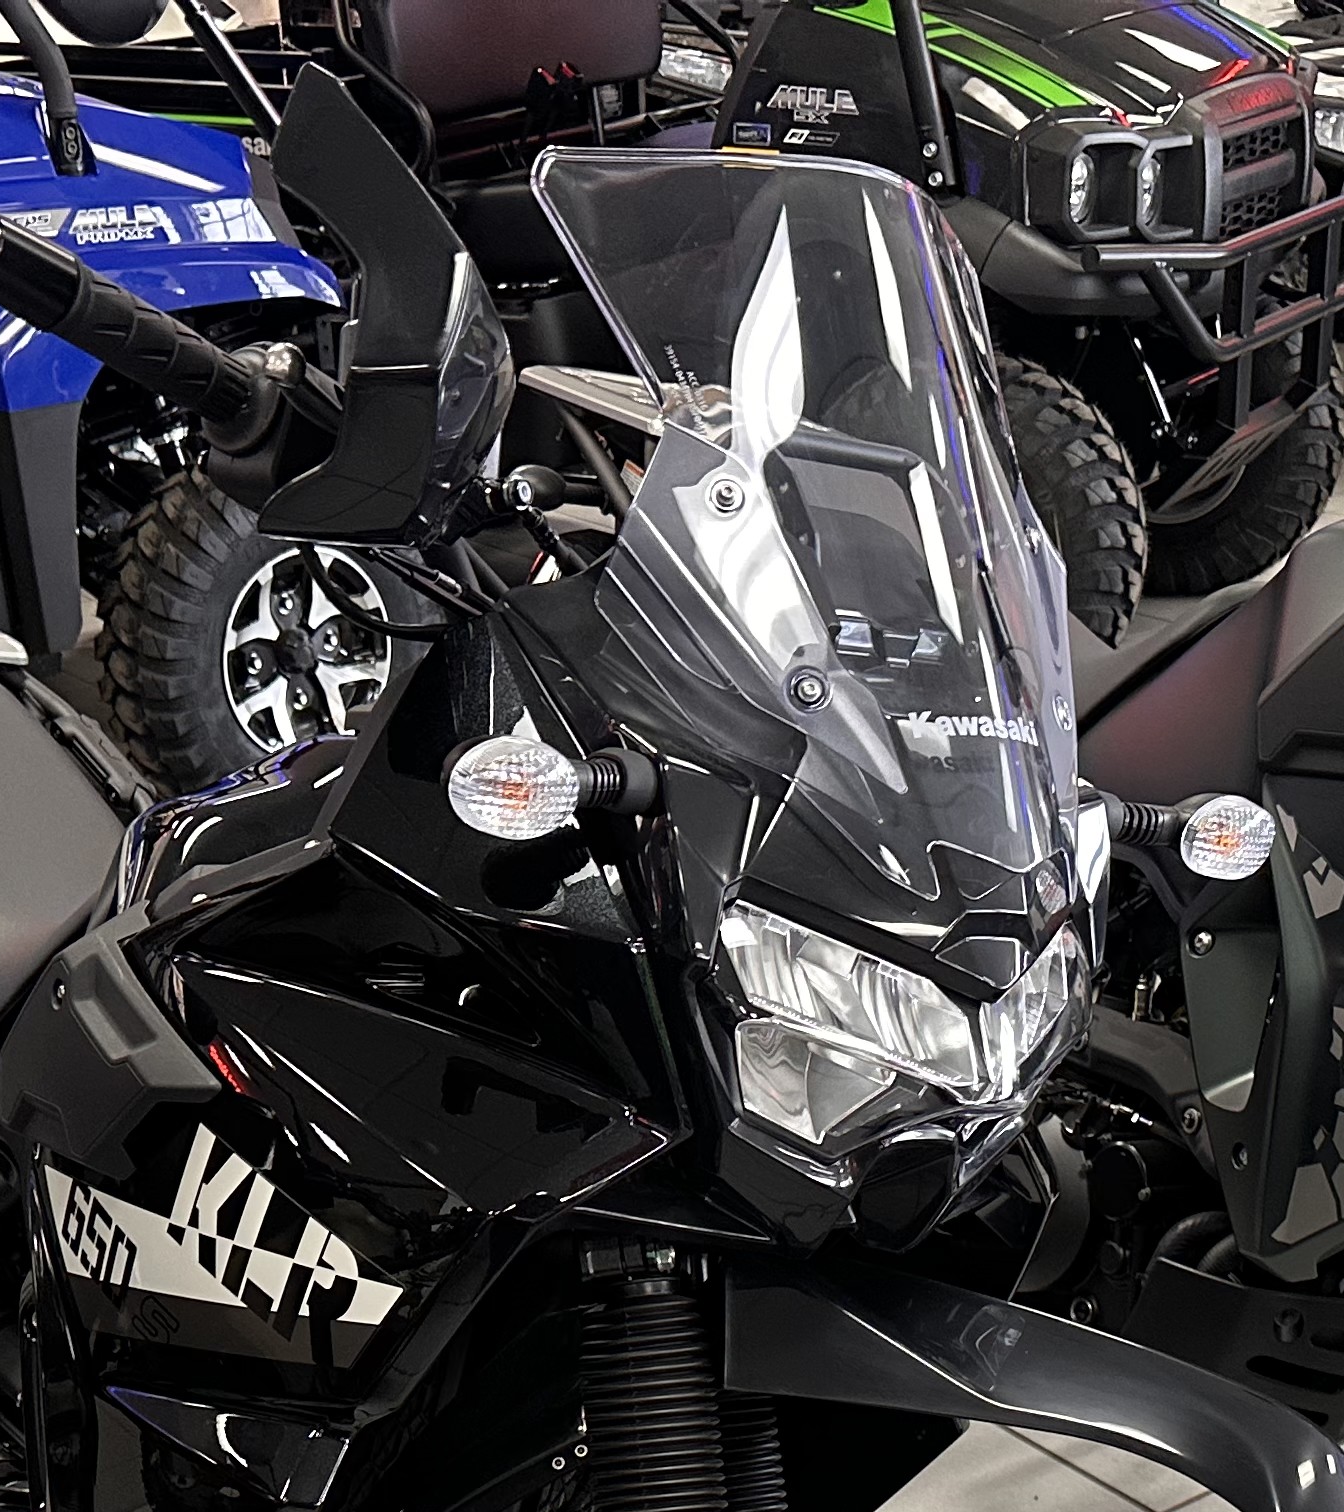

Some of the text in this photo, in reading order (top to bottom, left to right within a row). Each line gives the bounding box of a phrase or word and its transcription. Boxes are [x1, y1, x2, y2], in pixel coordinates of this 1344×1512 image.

[767, 84, 859, 115] MULE
[908, 711, 1039, 746] Kawasaki
[61, 1177, 138, 1310] 650
[166, 1123, 358, 1367] KLR
